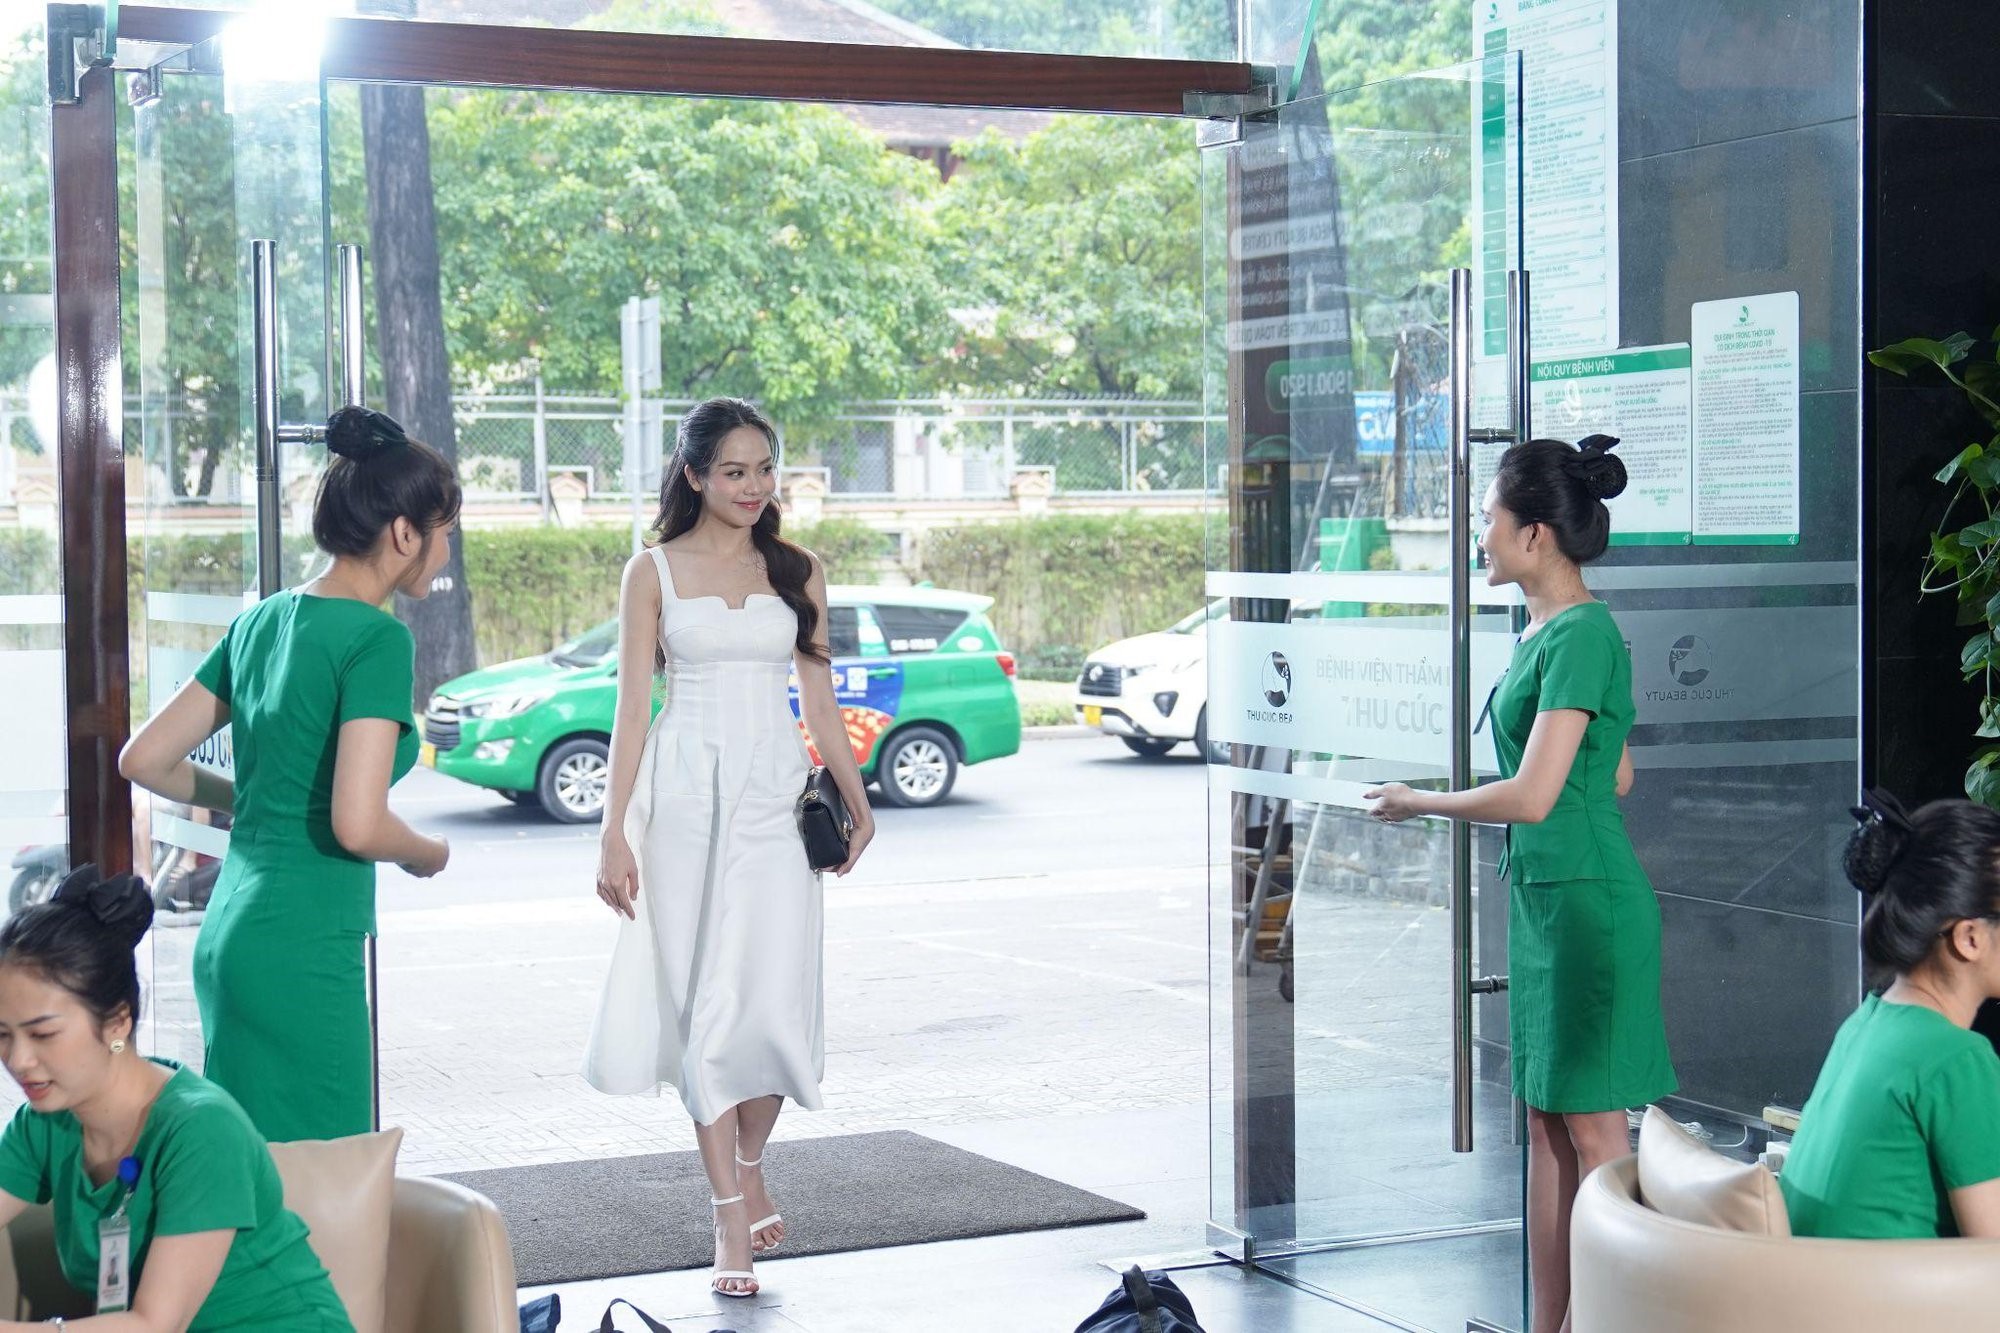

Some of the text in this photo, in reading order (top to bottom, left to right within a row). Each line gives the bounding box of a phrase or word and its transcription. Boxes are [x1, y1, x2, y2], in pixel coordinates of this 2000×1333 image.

[1537, 358, 1615, 378] NỘI QUY BỆNH VIỆN
[1316, 654, 1354, 684] BỆNH
[1360, 657, 1392, 688] VIỆN
[1397, 656, 1441, 687] THẨM
[1247, 709, 1261, 722] THU
[1261, 711, 1277, 724] CUC
[1341, 693, 1444, 735] THU CÚC
